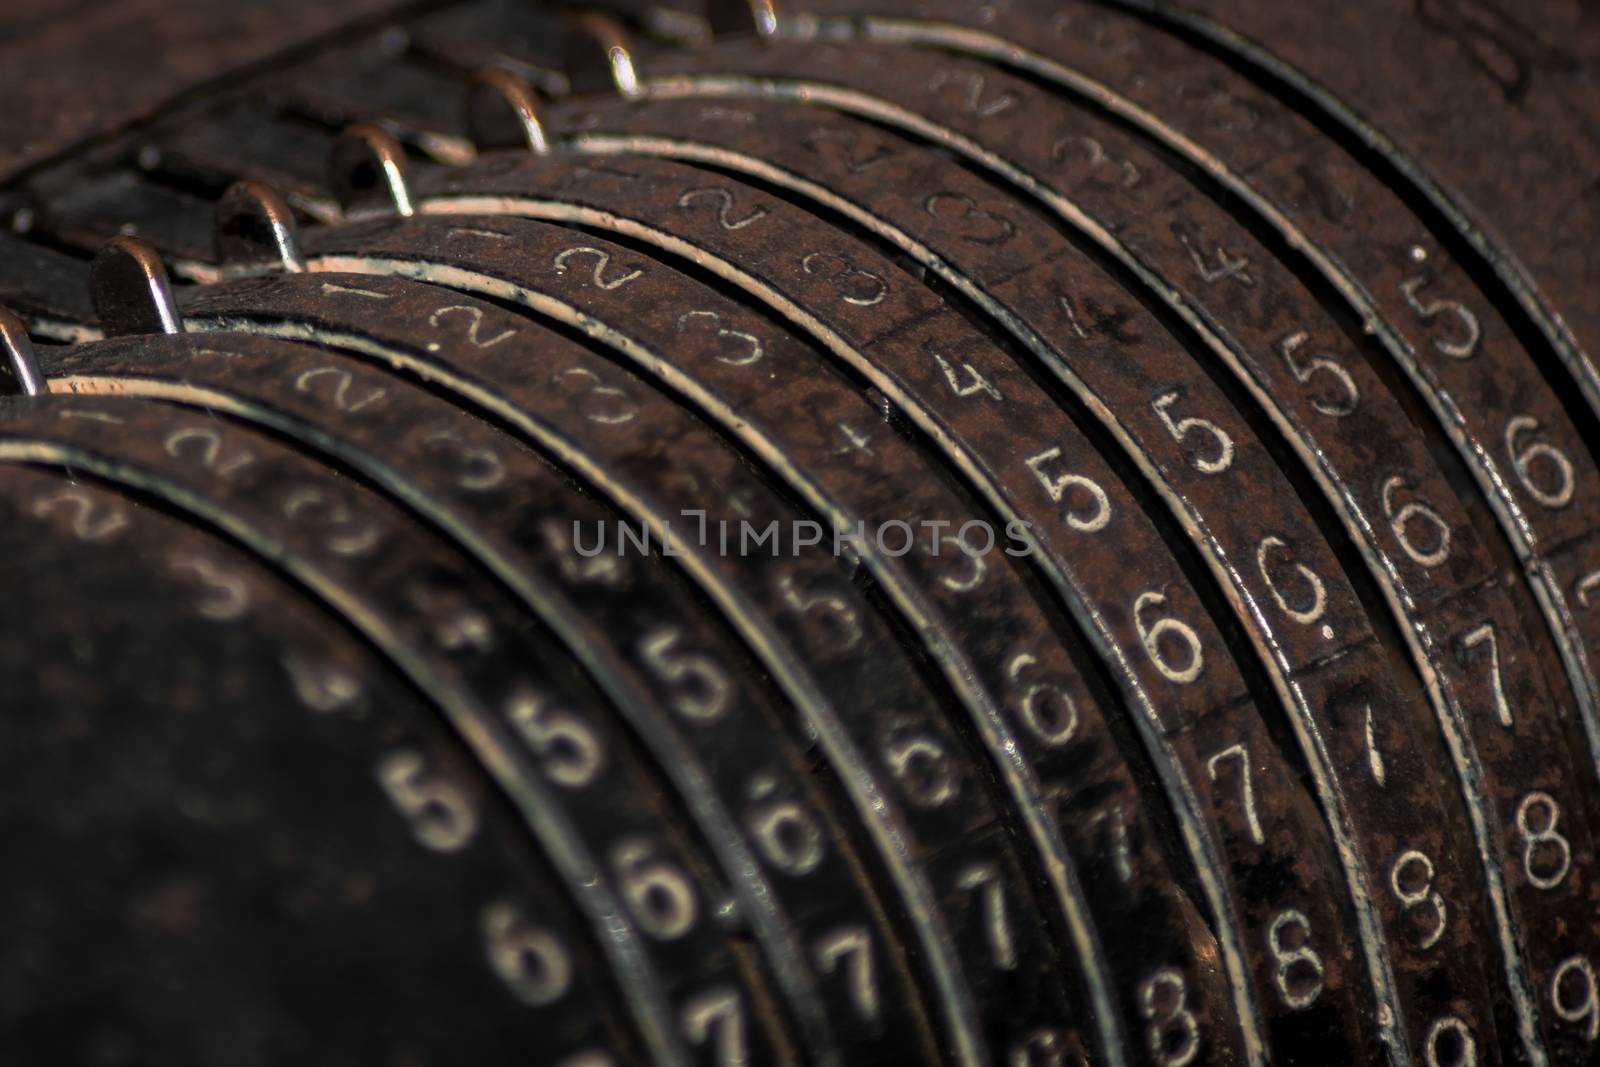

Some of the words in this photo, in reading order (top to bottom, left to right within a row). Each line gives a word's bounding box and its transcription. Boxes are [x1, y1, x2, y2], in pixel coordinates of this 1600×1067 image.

[296, 366, 386, 412] 2
[638, 625, 730, 724] 5
[748, 773, 825, 877] 6
[818, 922, 884, 1024] 7
[321, 282, 393, 299] 1
[428, 304, 517, 349] 2
[955, 860, 1020, 971] 7
[553, 246, 643, 291] 2
[678, 310, 764, 366] 3
[1009, 653, 1078, 746] 6
[679, 188, 767, 230] 2
[802, 252, 888, 306] 3
[930, 345, 1002, 400] 4
[1024, 447, 1111, 532] 5
[1133, 591, 1201, 684] 6
[1207, 744, 1264, 846] 7
[1269, 909, 1323, 1010] 8
[1152, 391, 1234, 474] 5
[1257, 535, 1326, 624] 6
[1176, 222, 1253, 285] 4
[1280, 330, 1360, 416] 5
[1382, 475, 1450, 567] 6
[1462, 624, 1513, 727] 7
[1516, 791, 1570, 889] 8
[1551, 955, 1600, 1042] 9
[1400, 274, 1482, 358] 5
[1504, 415, 1575, 508] 6
[164, 427, 256, 478] 2
[504, 685, 602, 789] 5
[609, 836, 697, 941] 6
[683, 984, 748, 1067] 7
[374, 748, 479, 854] 5
[480, 902, 574, 1008] 6
